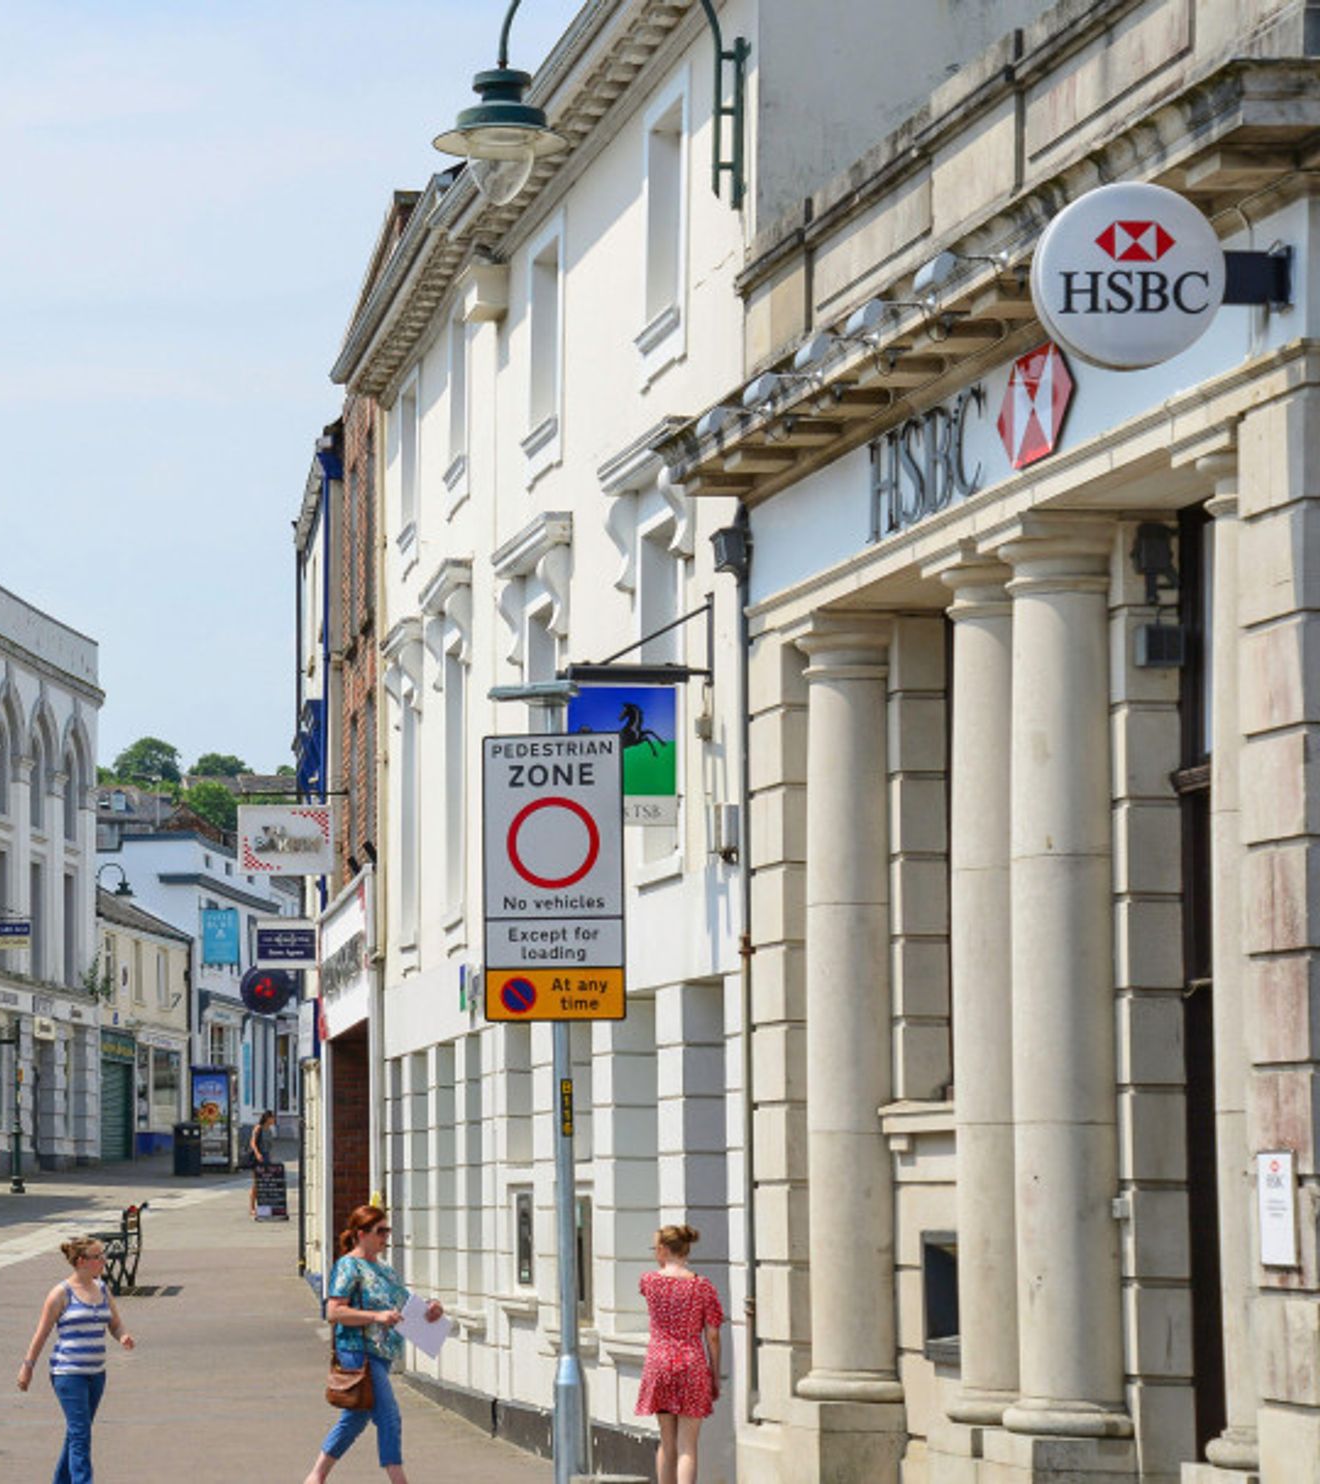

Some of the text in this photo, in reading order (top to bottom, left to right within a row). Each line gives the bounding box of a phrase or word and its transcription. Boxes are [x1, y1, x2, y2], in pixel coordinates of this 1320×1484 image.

[1058, 270, 1209, 314] HSBC
[865, 381, 987, 543] HSBC
[491, 740, 613, 759] PEDESTRIAN
[508, 763, 596, 788] ZONE
[633, 804, 661, 819] TSB
[503, 895, 605, 911] No vehicles
[508, 926, 599, 944] Except for
[521, 945, 587, 962] loading
[551, 978, 609, 995] At any
[560, 997, 599, 1011] time
